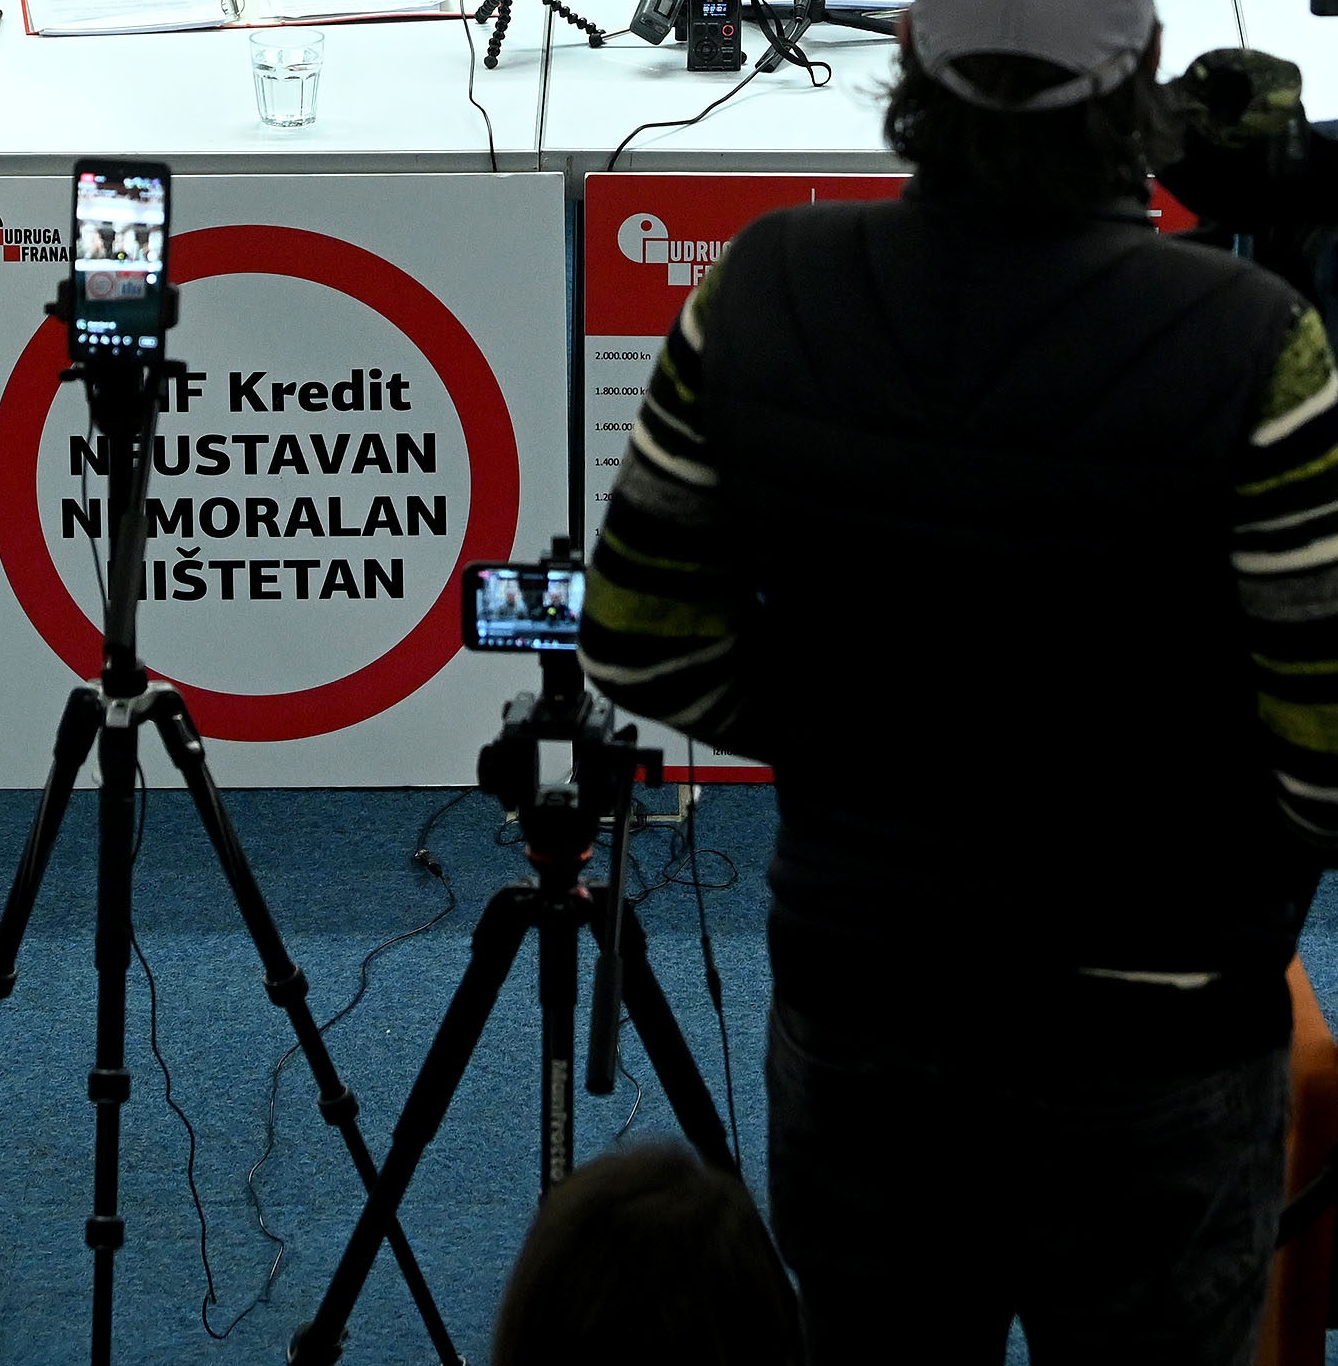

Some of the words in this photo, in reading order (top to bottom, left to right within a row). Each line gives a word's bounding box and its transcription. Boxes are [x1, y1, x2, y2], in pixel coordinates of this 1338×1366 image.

[4, 228, 62, 245] UDRUGA
[21, 246, 72, 262] FRANA
[670, 240, 730, 262] UDRU
[594, 351, 638, 362] 2.000.000
[640, 350, 652, 362] kn
[228, 367, 413, 413] Kredit
[594, 386, 638, 397] 1.800.000
[61, 494, 448, 539] NMORALAN
